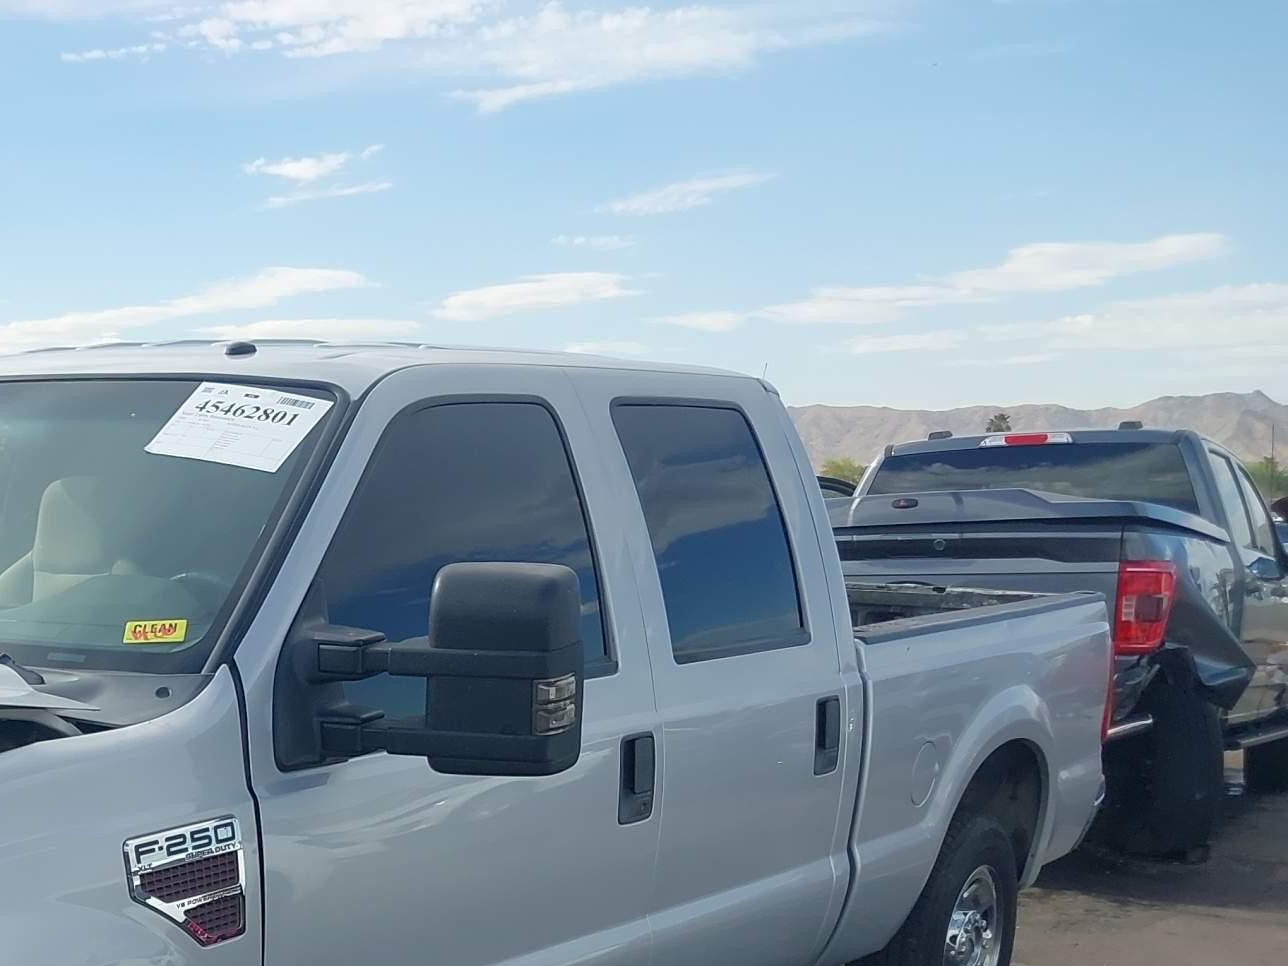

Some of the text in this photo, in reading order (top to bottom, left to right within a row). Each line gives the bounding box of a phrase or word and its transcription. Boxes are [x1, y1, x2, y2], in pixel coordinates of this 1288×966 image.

[195, 399, 301, 427] 45462801
[133, 623, 178, 634] CLEAN
[134, 822, 236, 865] F-250
[186, 843, 236, 860] SUPER DUTY
